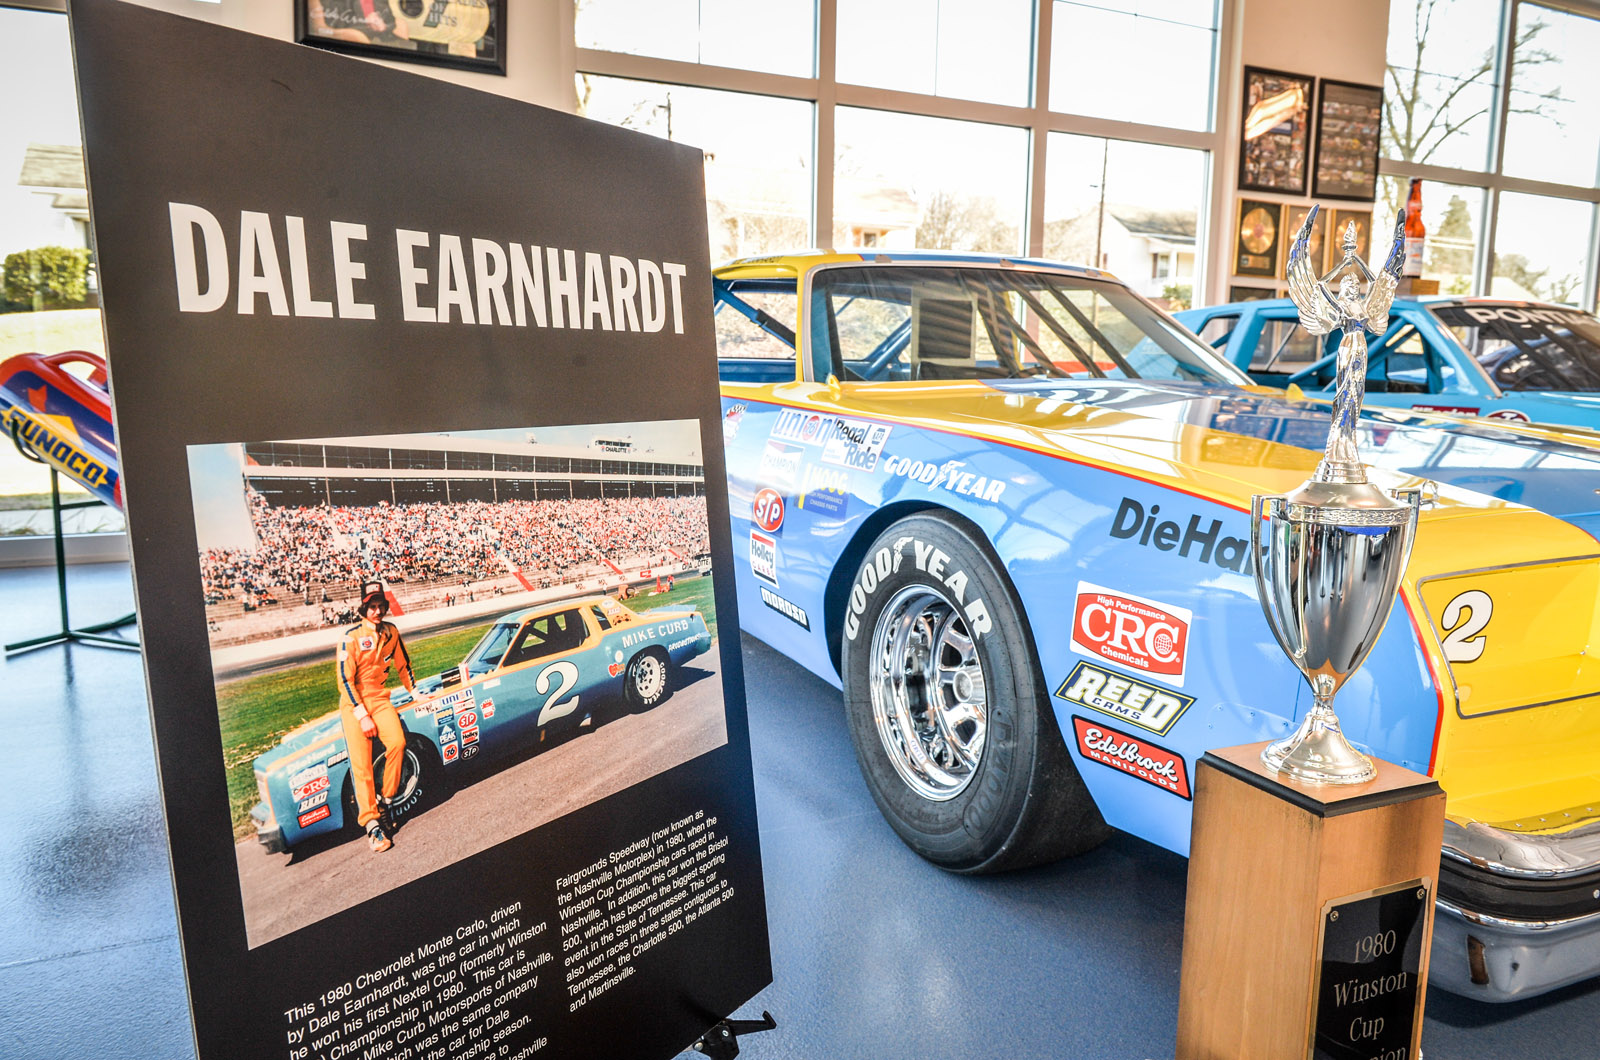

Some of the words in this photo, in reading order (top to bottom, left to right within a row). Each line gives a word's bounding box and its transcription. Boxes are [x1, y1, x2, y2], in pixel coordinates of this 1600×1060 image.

[168, 201, 376, 320] DALE
[396, 228, 687, 335] EARNHARDT
[605, 446, 627, 454] CHARLOTTE
[844, 443, 877, 470] Ride
[754, 490, 782, 526] STP
[751, 538, 774, 567] Holley
[1110, 496, 1271, 582] DieHar
[761, 587, 807, 627] MOROSO
[1097, 595, 1115, 608] High
[1115, 600, 1166, 622] Performance
[1441, 589, 1494, 664] 2
[622, 627, 656, 648] MIKE
[658, 619, 689, 637] CURB
[1081, 603, 1180, 664] CRC
[1101, 644, 1149, 669] Chemicals
[535, 660, 580, 727] 2
[1066, 666, 1181, 731] REED
[1092, 697, 1141, 720] CAMS
[440, 731, 457, 745] PEAK
[461, 713, 475, 727] STP
[446, 746, 456, 758] 76
[464, 746, 477, 758] STP
[1084, 727, 1179, 782] Edelbrock
[1090, 750, 1179, 791] MANIFOLDS
[302, 776, 329, 796] CRC
[556, 858, 608, 890] Fairgrounds
[609, 836, 650, 863] Speedway
[651, 826, 670, 844] (now
[670, 815, 694, 832] known
[695, 809, 704, 820] as
[557, 892, 572, 906] the
[574, 871, 613, 897] Nashville
[614, 847, 655, 876] Motorplex)
[656, 844, 664, 854] in
[665, 832, 685, 849] 1980,
[686, 823, 705, 838] when
[706, 816, 717, 828] the
[559, 896, 595, 921] Winston
[596, 886, 614, 901] Cup
[616, 856, 670, 890] Championship
[671, 847, 687, 861] cars
[688, 833, 707, 852] raced
[708, 831, 715, 841] in
[561, 909, 603, 936] Nashville.
[607, 900, 616, 911] In
[618, 882, 651, 905] addition,
[652, 872, 666, 886] this
[667, 865, 679, 878] car
[679, 856, 695, 870] won
[695, 850, 707, 861] the
[708, 835, 728, 855] Bristol
[563, 934, 582, 951] 500,
[584, 919, 609, 939] which
[610, 910, 626, 925] has
[627, 892, 658, 915] become
[659, 884, 671, 897] the
[672, 867, 698, 889] biggest
[699, 853, 725, 874] sporting
[564, 945, 589, 967] event
[590, 941, 599, 952] in
[600, 932, 614, 946] the
[616, 919, 637, 937] State
[638, 910, 646, 924] of
[647, 890, 689, 917] Tennessee.
[689, 879, 705, 892] This
[706, 871, 717, 884] car
[566, 965, 585, 982] also
[586, 953, 605, 969] won
[606, 939, 629, 958] races
[630, 933, 638, 944] in
[639, 921, 659, 938] three
[660, 906, 683, 925] states
[683, 884, 720, 911] contiguous
[720, 879, 728, 889] to
[567, 963, 616, 996] Tennessee,
[617, 953, 631, 966] the
[632, 931, 667, 957] Charlotte
[668, 919, 684, 935] 500,
[685, 912, 697, 925] the
[698, 897, 721, 917] Atlanta
[722, 887, 734, 902] 500
[1353, 929, 1397, 964] 1980
[284, 1003, 315, 1024] This
[319, 982, 352, 1007] 1980
[356, 952, 415, 989] Chevrolet
[418, 935, 453, 960] Monte
[456, 920, 488, 940] Carlo,
[490, 901, 521, 923] driven
[287, 1027, 305, 1044] by
[308, 1010, 340, 1033] Dale
[344, 975, 409, 1015] Earnhardt,
[411, 962, 436, 980] was
[438, 952, 456, 967] the
[459, 940, 476, 957] car
[478, 935, 489, 947] in
[491, 918, 520, 940] which
[290, 1046, 308, 1060] he
[311, 1030, 340, 1051] won
[343, 1018, 363, 1035] his
[366, 1002, 390, 1023] first
[392, 980, 430, 1010] Nextel
[433, 969, 457, 987] Cup
[460, 943, 505, 976] (formerly
[507, 922, 547, 948] Winston
[330, 1007, 419, 1060] Championship
[422, 1000, 433, 1012] in
[436, 981, 467, 1004] 1980.
[472, 966, 496, 984] This
[498, 955, 514, 971] car
[516, 950, 526, 961] is
[363, 1040, 393, 1060] Mike
[397, 1021, 426, 1044] Curb
[429, 985, 493, 1027] Motorsports
[495, 974, 505, 990] of
[507, 952, 554, 983] Nashville,
[415, 1033, 439, 1052] was
[441, 1022, 459, 1038] the
[462, 1003, 491, 1026] same
[494, 975, 538, 1008] company
[570, 993, 586, 1012] and
[588, 966, 636, 1000] Martinsville.
[1333, 970, 1408, 1008] Winston
[427, 1047, 446, 1060] the
[449, 1034, 466, 1051] car
[469, 1024, 483, 1040] for
[486, 1010, 510, 1030] Dale
[493, 1015, 532, 1043] season.
[498, 1045, 509, 1056] to
[1349, 1015, 1386, 1042] Cup
